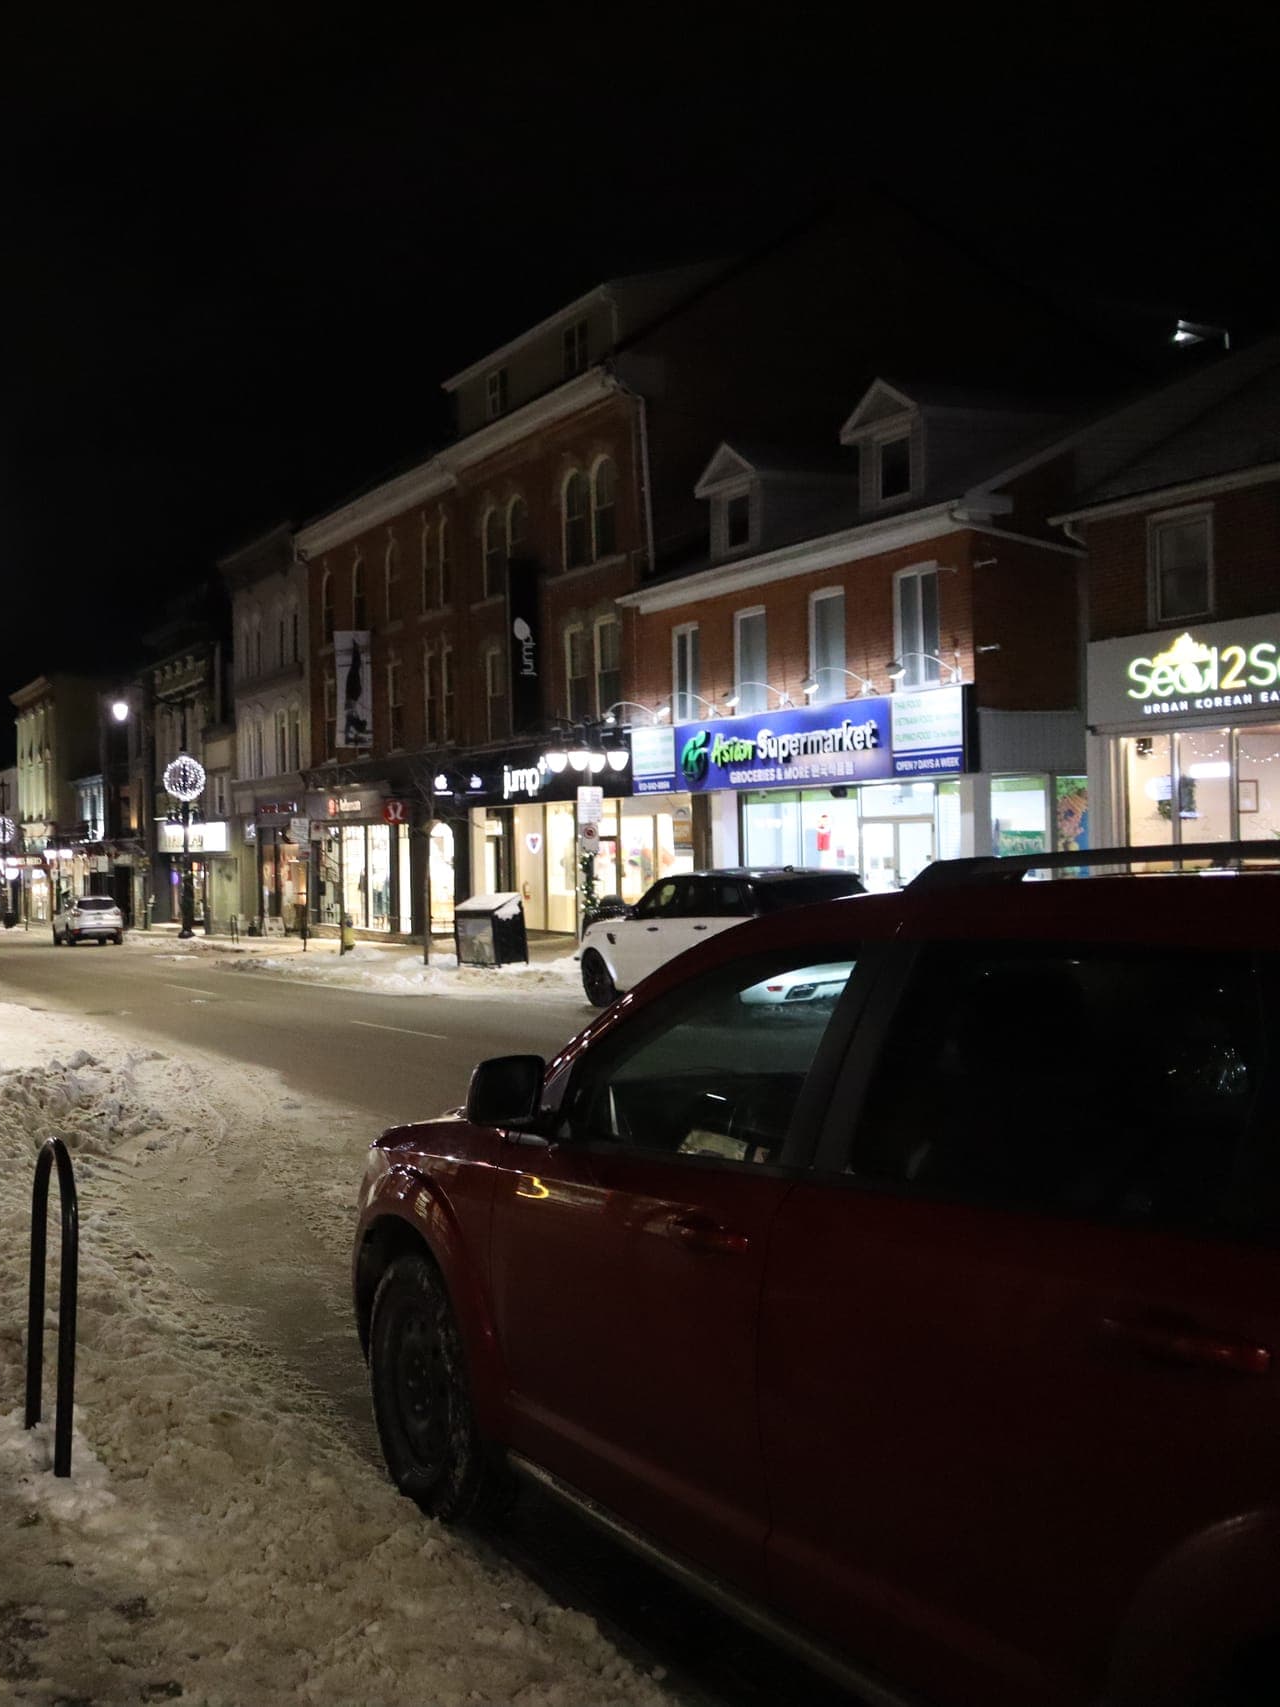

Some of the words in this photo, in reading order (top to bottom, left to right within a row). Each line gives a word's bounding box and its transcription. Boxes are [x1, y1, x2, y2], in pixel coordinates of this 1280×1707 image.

[1143, 701, 1188, 715] URBAN
[1194, 693, 1253, 709] KOREAN
[1260, 690, 1280, 702] EA
[756, 719, 877, 763] Supermarket
[918, 758, 934, 770] DAYS
[934, 758, 940, 769] A
[940, 756, 960, 768] WEEK
[729, 767, 776, 784] GROCERIES
[776, 767, 783, 781] &
[784, 766, 810, 780] MORE
